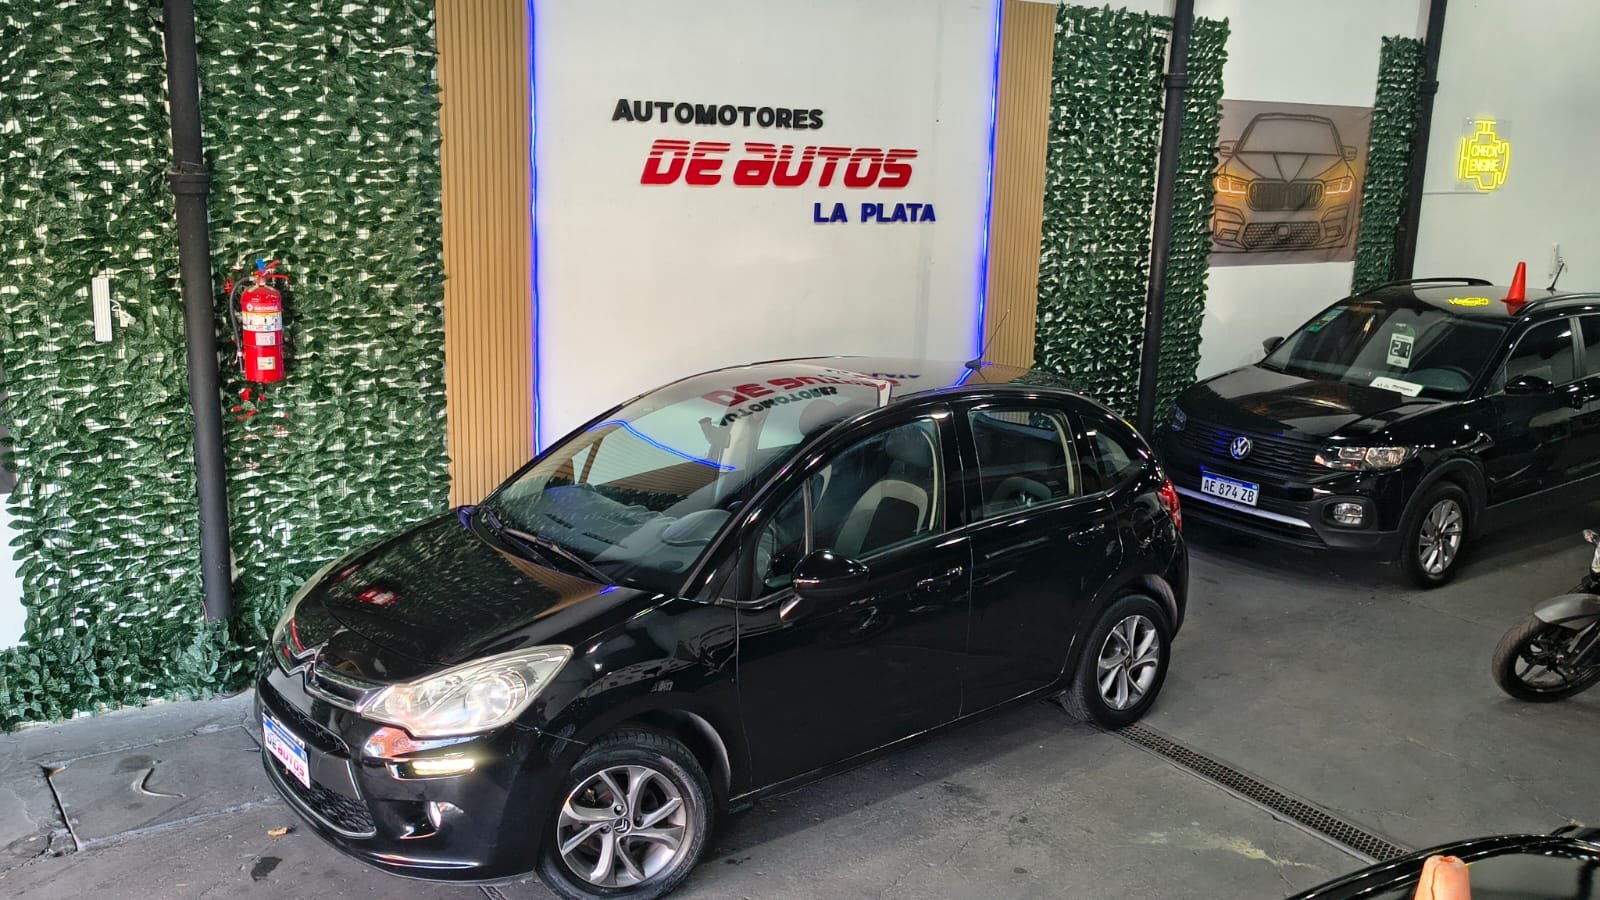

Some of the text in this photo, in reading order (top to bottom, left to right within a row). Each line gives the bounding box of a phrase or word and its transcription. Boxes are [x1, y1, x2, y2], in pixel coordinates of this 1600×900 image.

[611, 98, 824, 130] AUTOMOTORES
[640, 138, 732, 186] DE
[813, 202, 937, 223] LA PLATA
[1203, 479, 1217, 493] AE
[1218, 483, 1238, 498] 874
[1240, 488, 1255, 503] ZB
